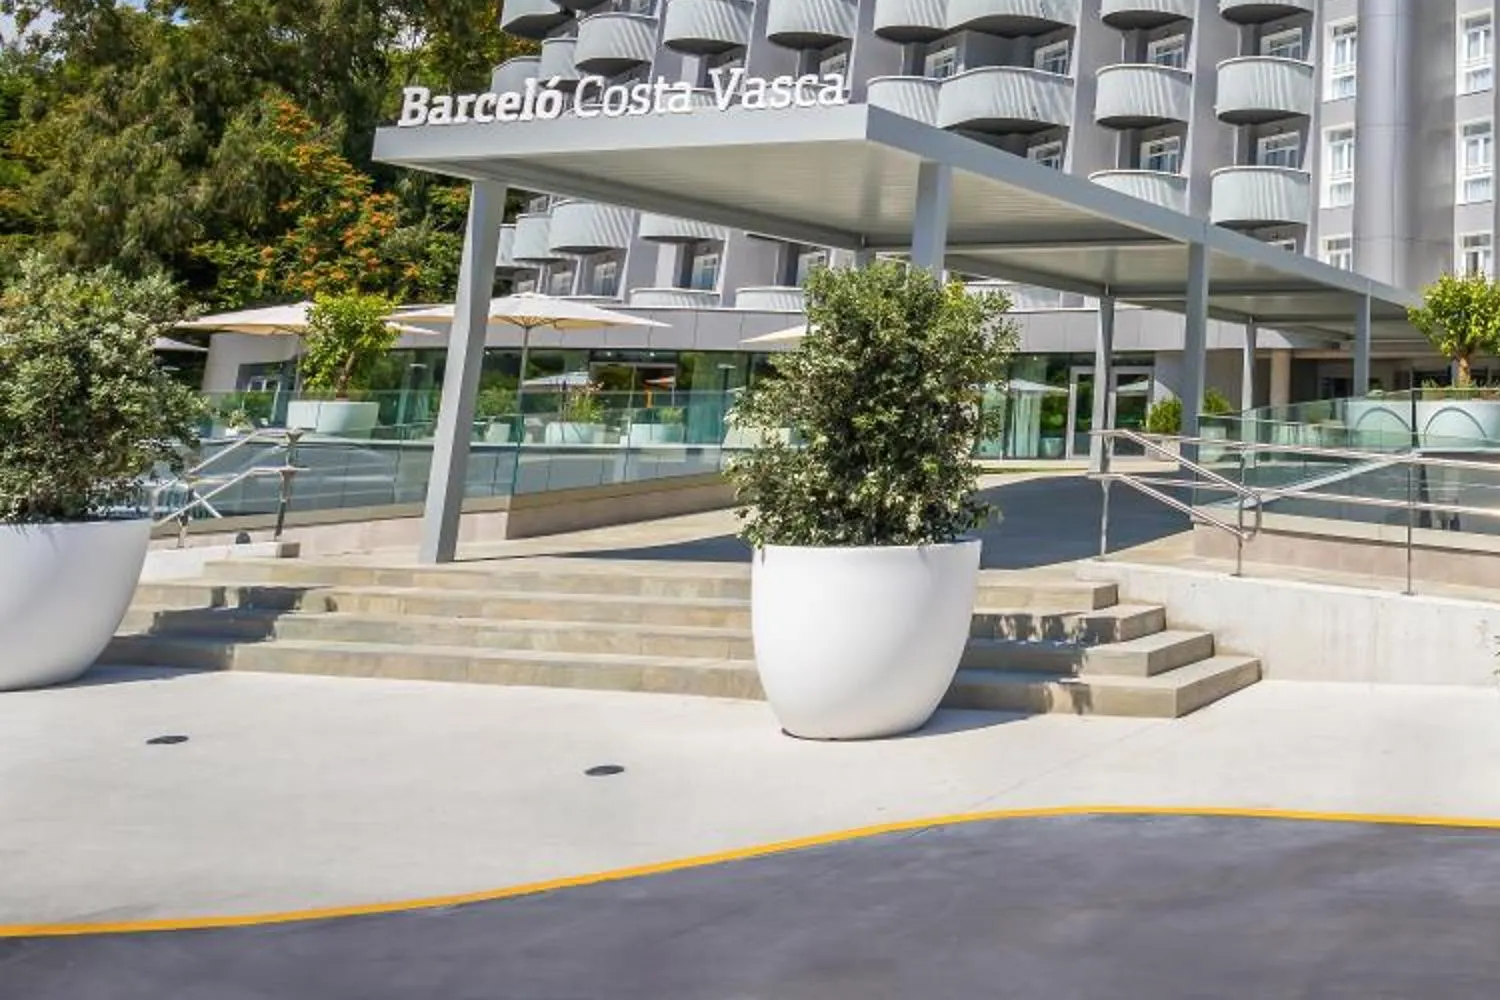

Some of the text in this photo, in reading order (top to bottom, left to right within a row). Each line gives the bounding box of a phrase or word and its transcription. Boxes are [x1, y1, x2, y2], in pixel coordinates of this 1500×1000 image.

[399, 67, 847, 126] Barceló Costa Vasca
